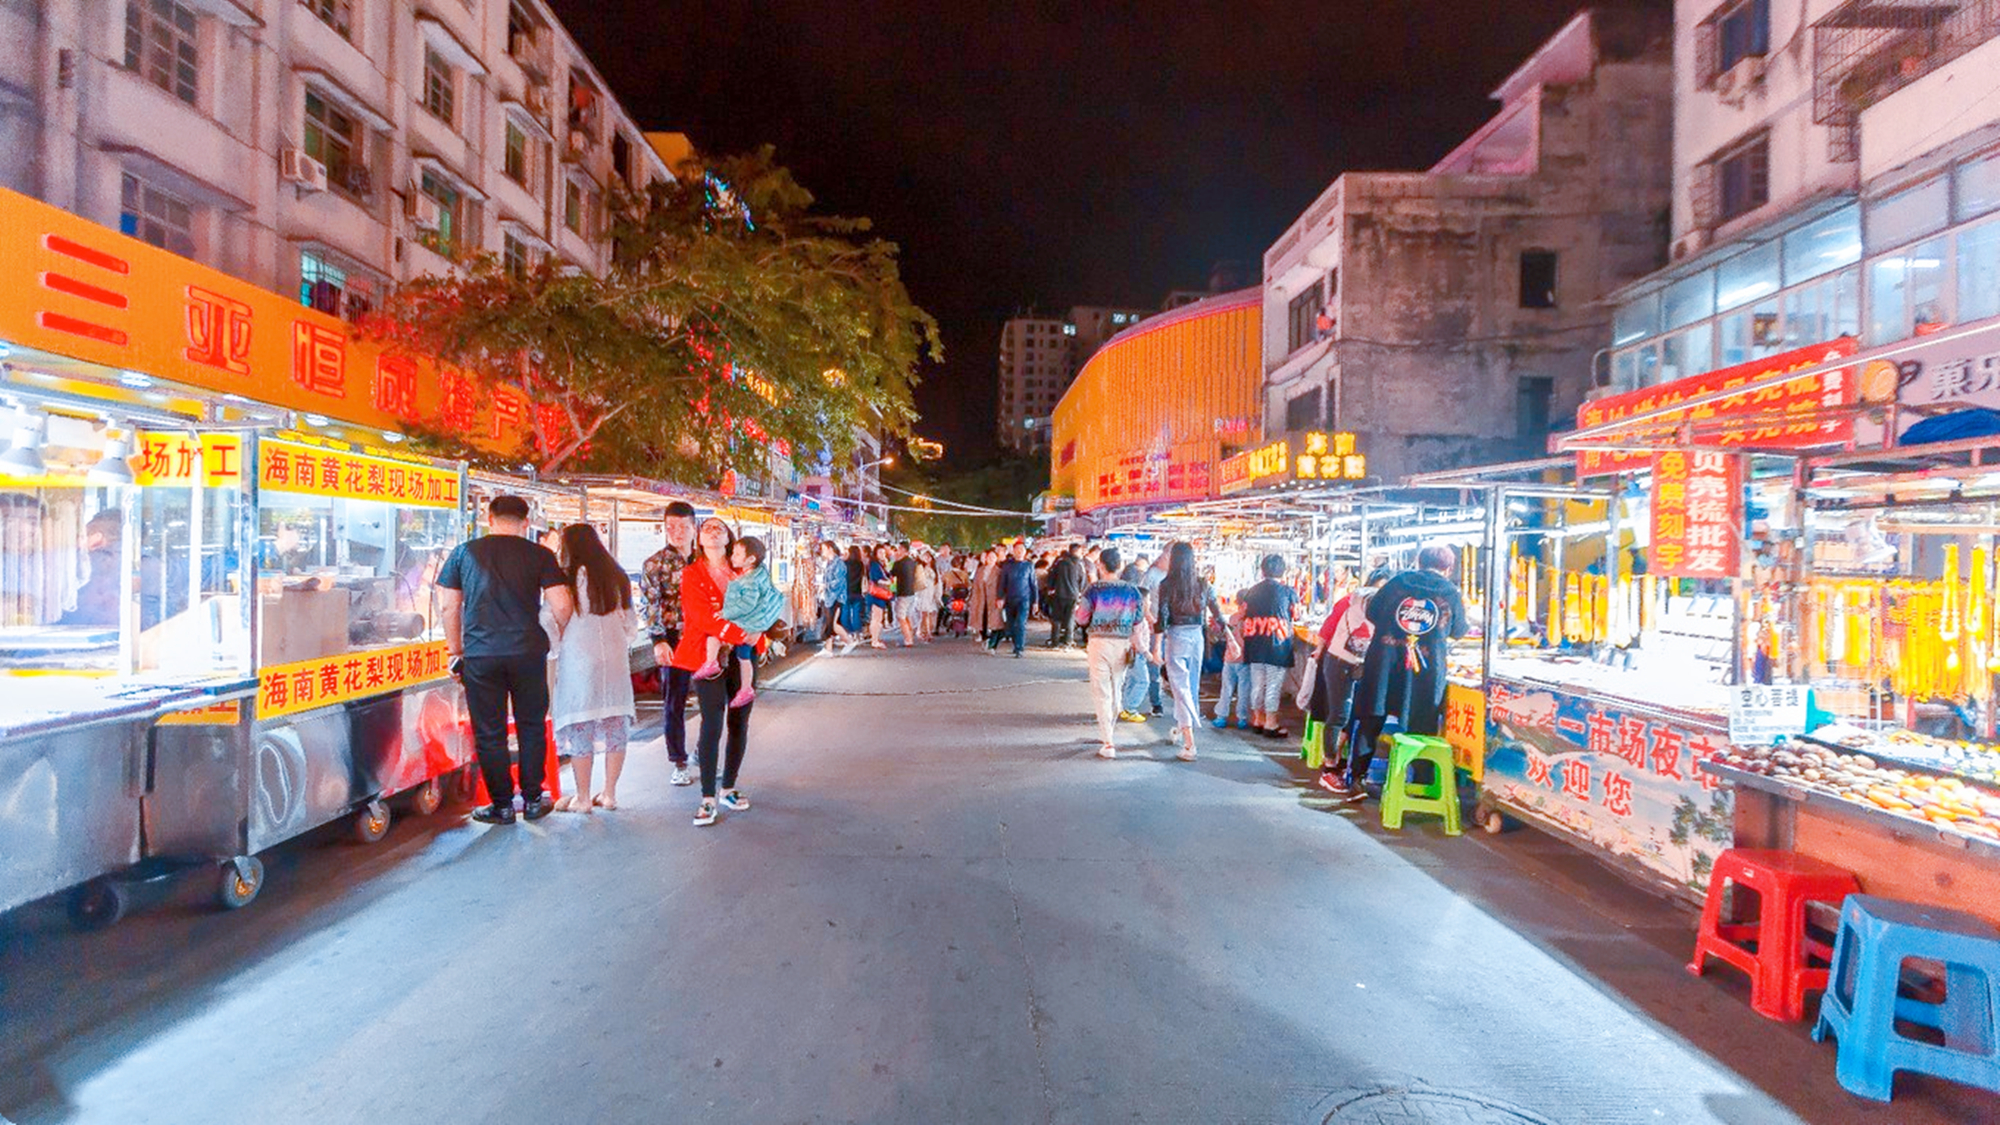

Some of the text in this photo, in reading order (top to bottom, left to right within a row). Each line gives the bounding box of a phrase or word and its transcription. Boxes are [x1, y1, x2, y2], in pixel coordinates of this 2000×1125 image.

[265, 447, 458, 502] 海南黄花梨现场加工
[1656, 452, 1687, 570] 免费刻字
[1686, 451, 1729, 571] 贝壳梳批发
[1446, 700, 1477, 740] 批发
[1527, 756, 1634, 817] 欢迎您
